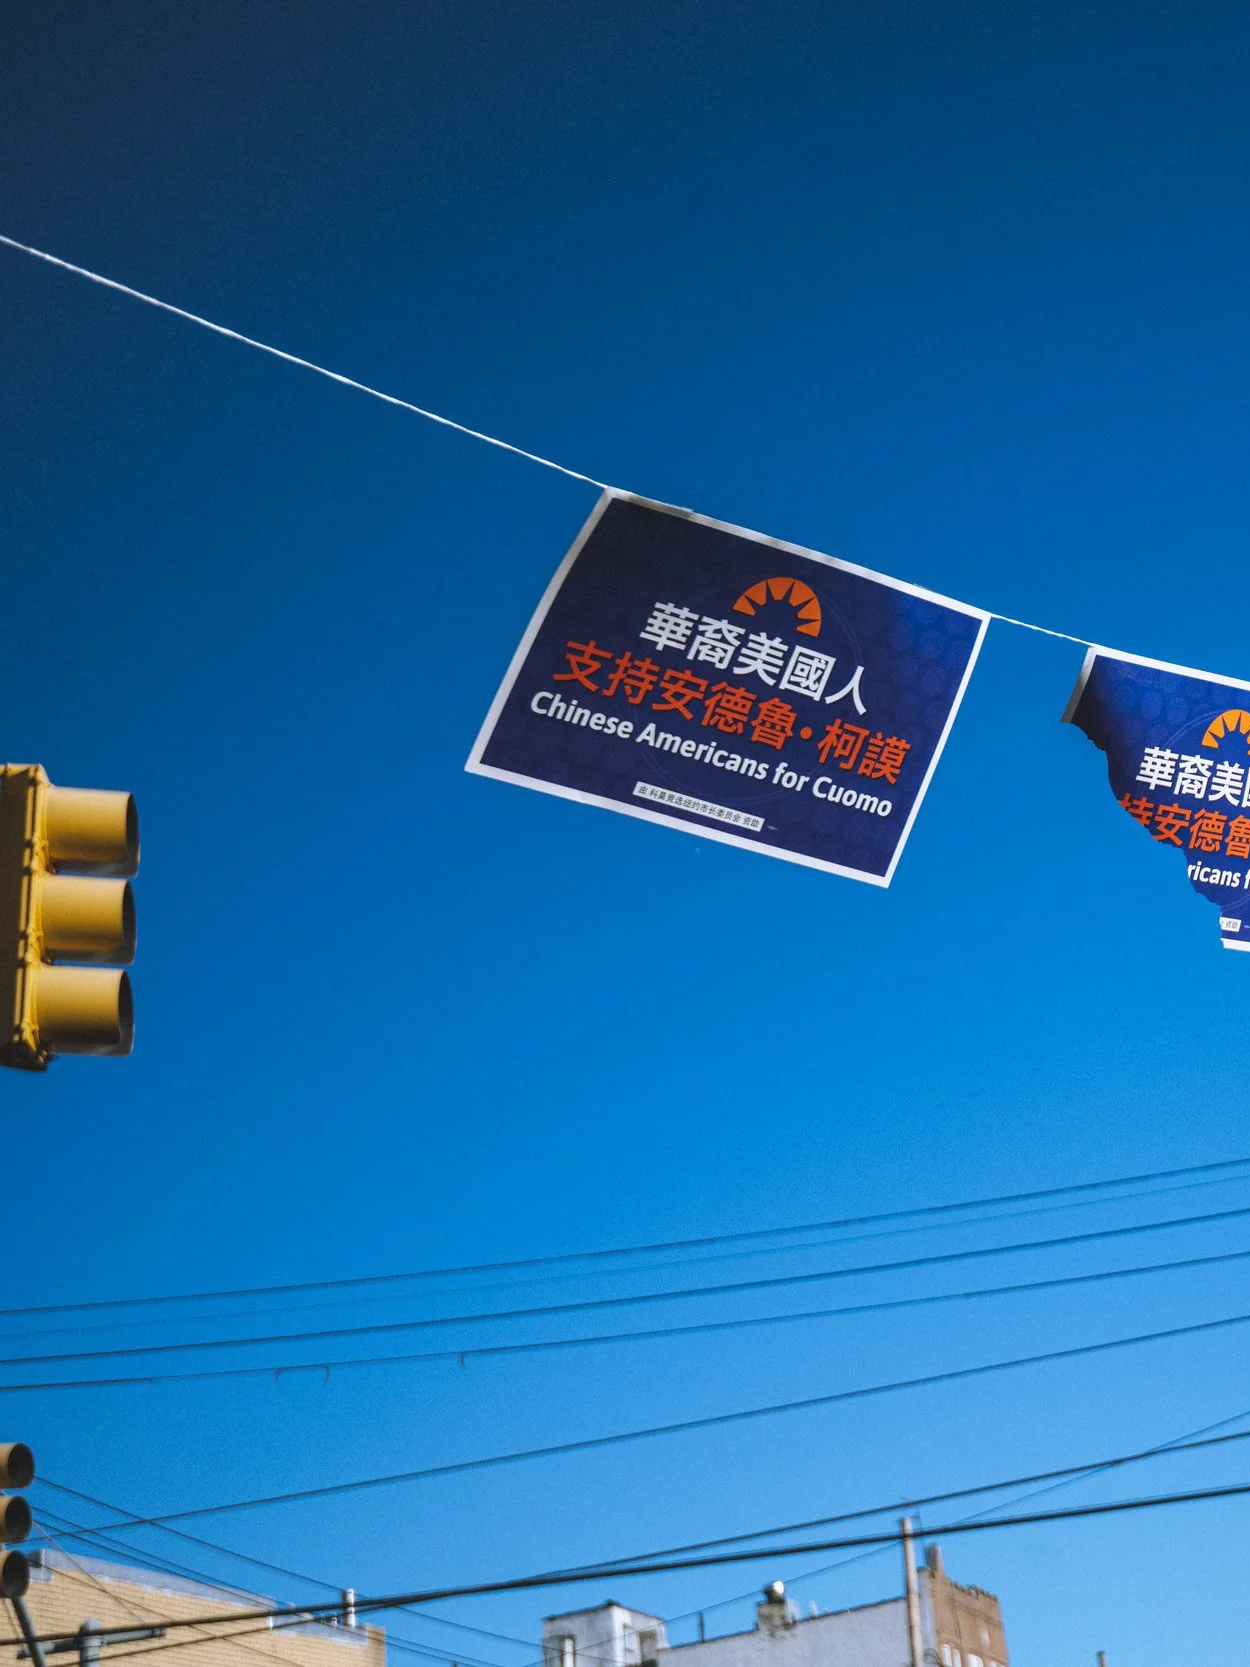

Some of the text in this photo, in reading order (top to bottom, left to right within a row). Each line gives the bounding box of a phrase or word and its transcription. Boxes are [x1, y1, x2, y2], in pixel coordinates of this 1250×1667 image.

[641, 602, 868, 715] 華裔美國人
[530, 690, 893, 818] Chinese Americans for Cuomo
